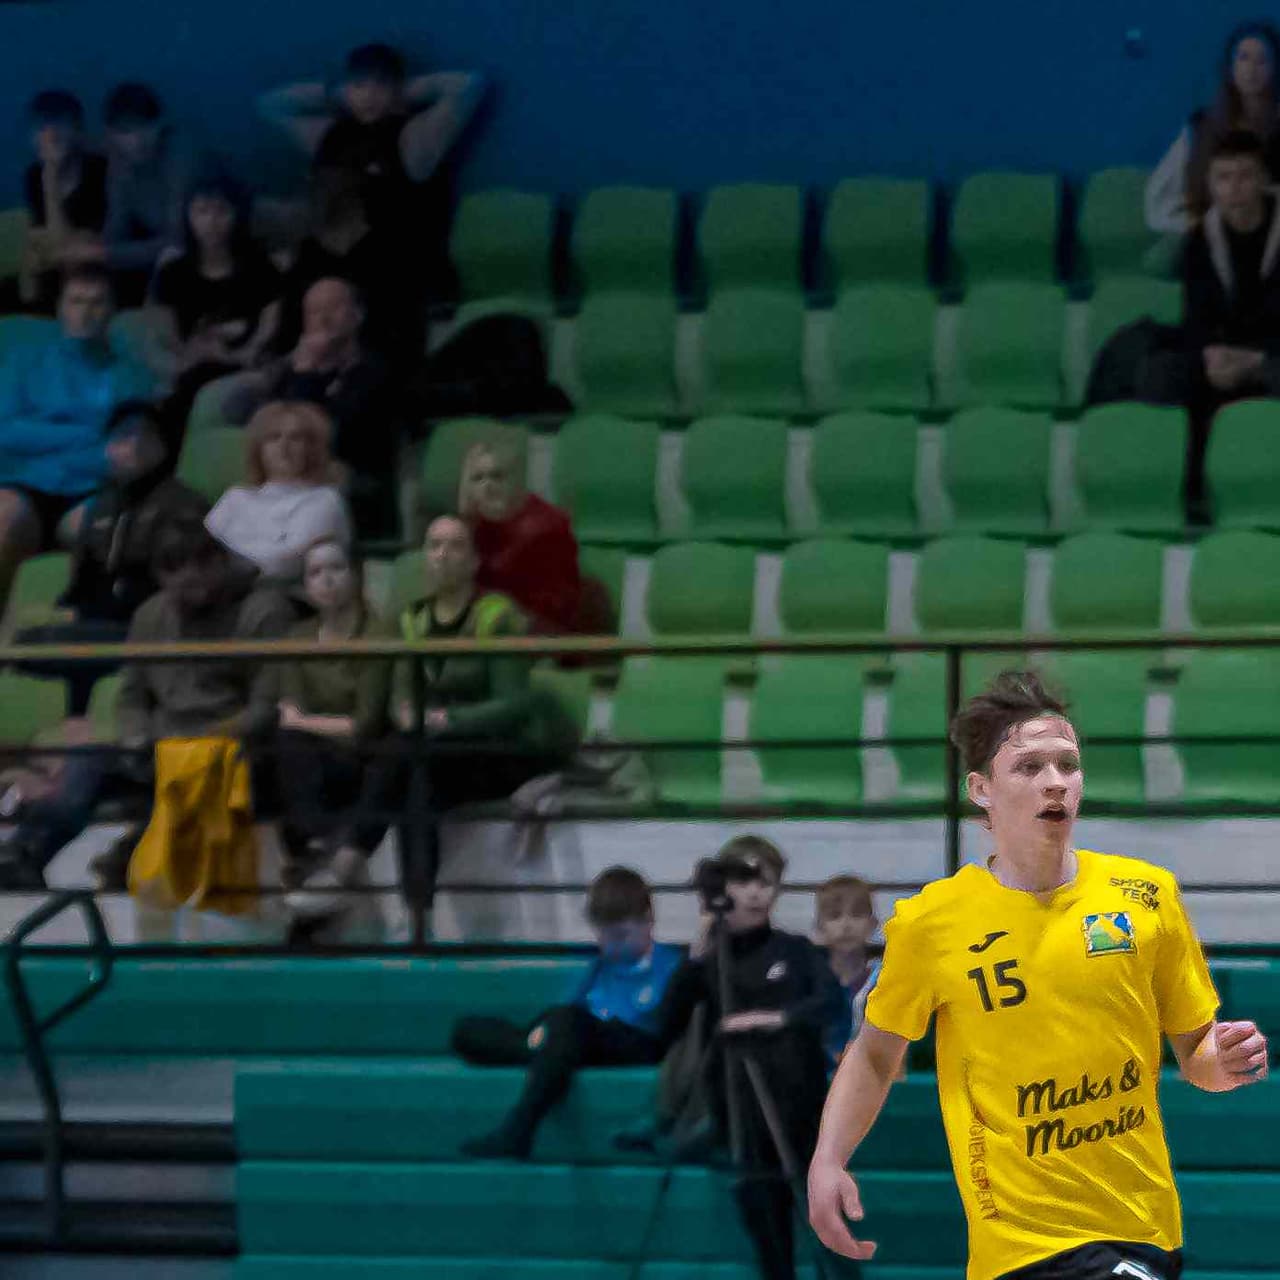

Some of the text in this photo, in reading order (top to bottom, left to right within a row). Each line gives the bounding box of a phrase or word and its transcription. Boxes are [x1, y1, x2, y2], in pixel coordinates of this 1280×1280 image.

[967, 958, 1028, 1013] 15
[1016, 1056, 1142, 1118] Maks &
[1025, 1104, 1146, 1158] Moorits
